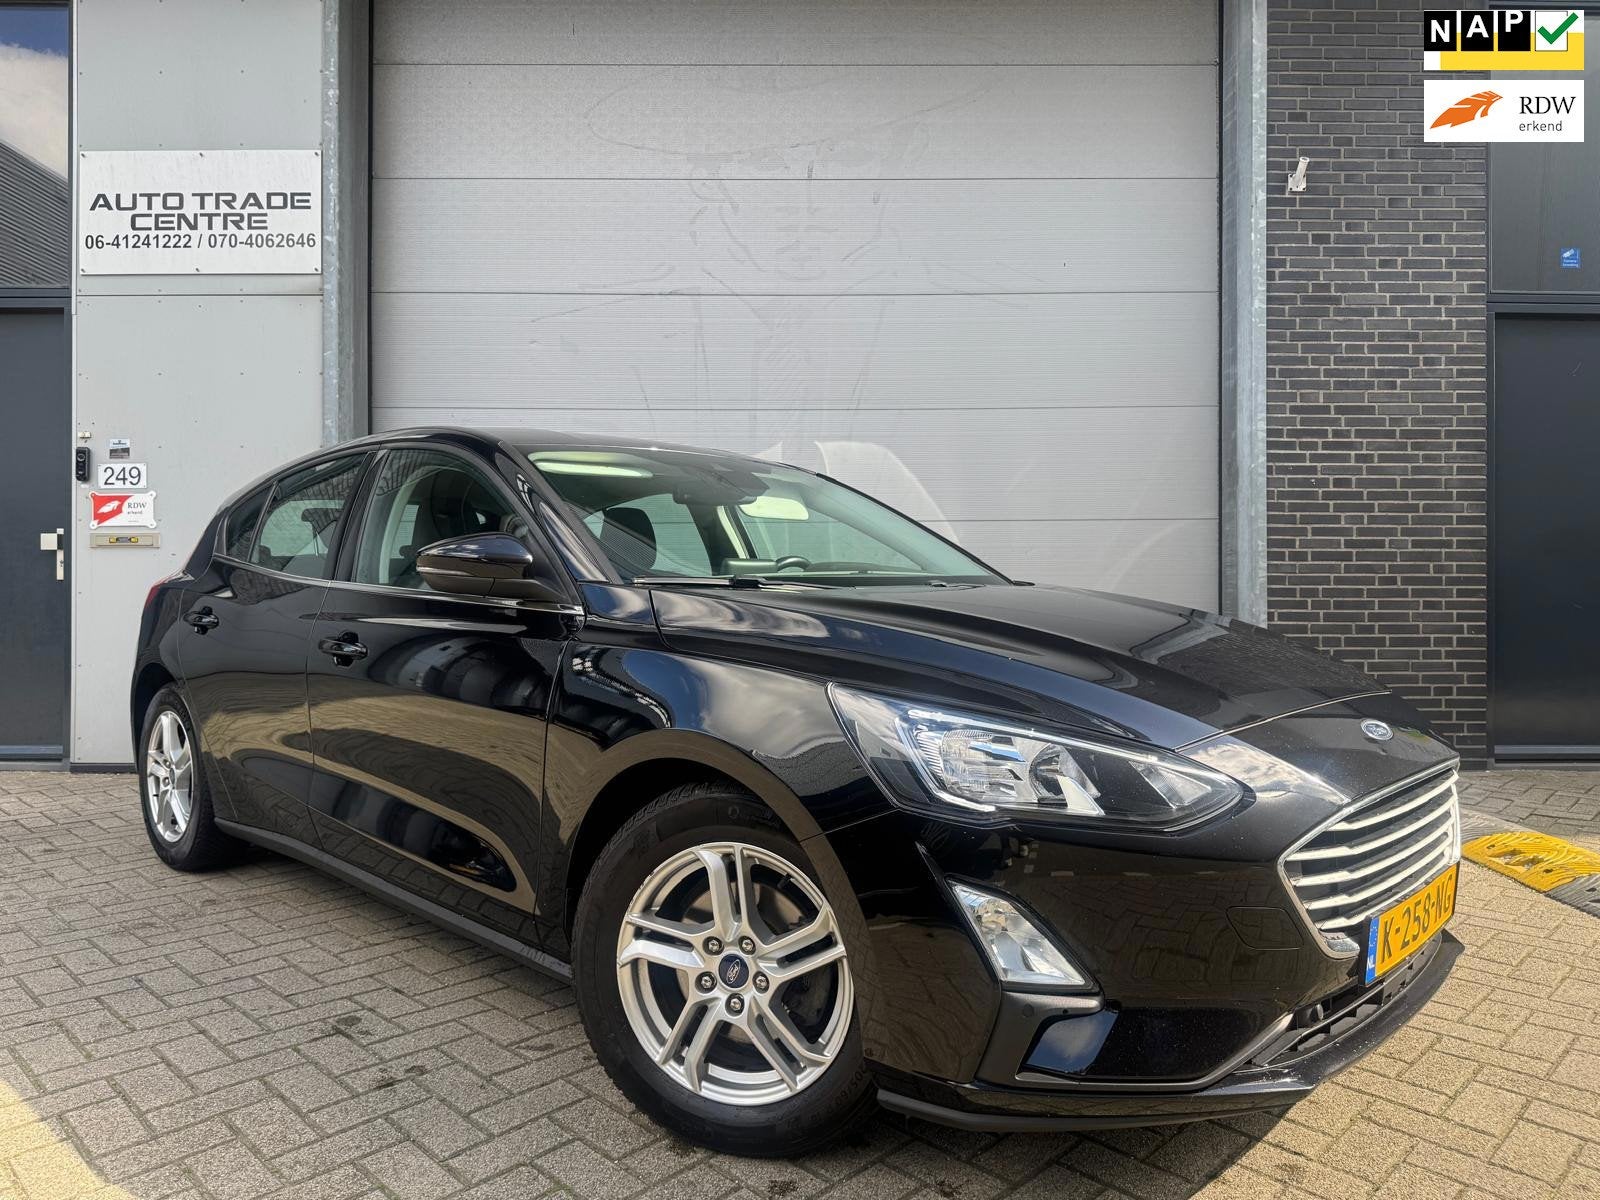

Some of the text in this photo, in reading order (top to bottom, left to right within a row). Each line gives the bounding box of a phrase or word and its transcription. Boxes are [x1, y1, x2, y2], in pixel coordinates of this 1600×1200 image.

[89, 191, 312, 211] AUTO TRADE
[130, 212, 269, 231] CENTRE
[85, 233, 316, 250] 06-41241222 / 070-4062646
[103, 466, 142, 486] 249
[1381, 873, 1453, 965] K-258-NG
